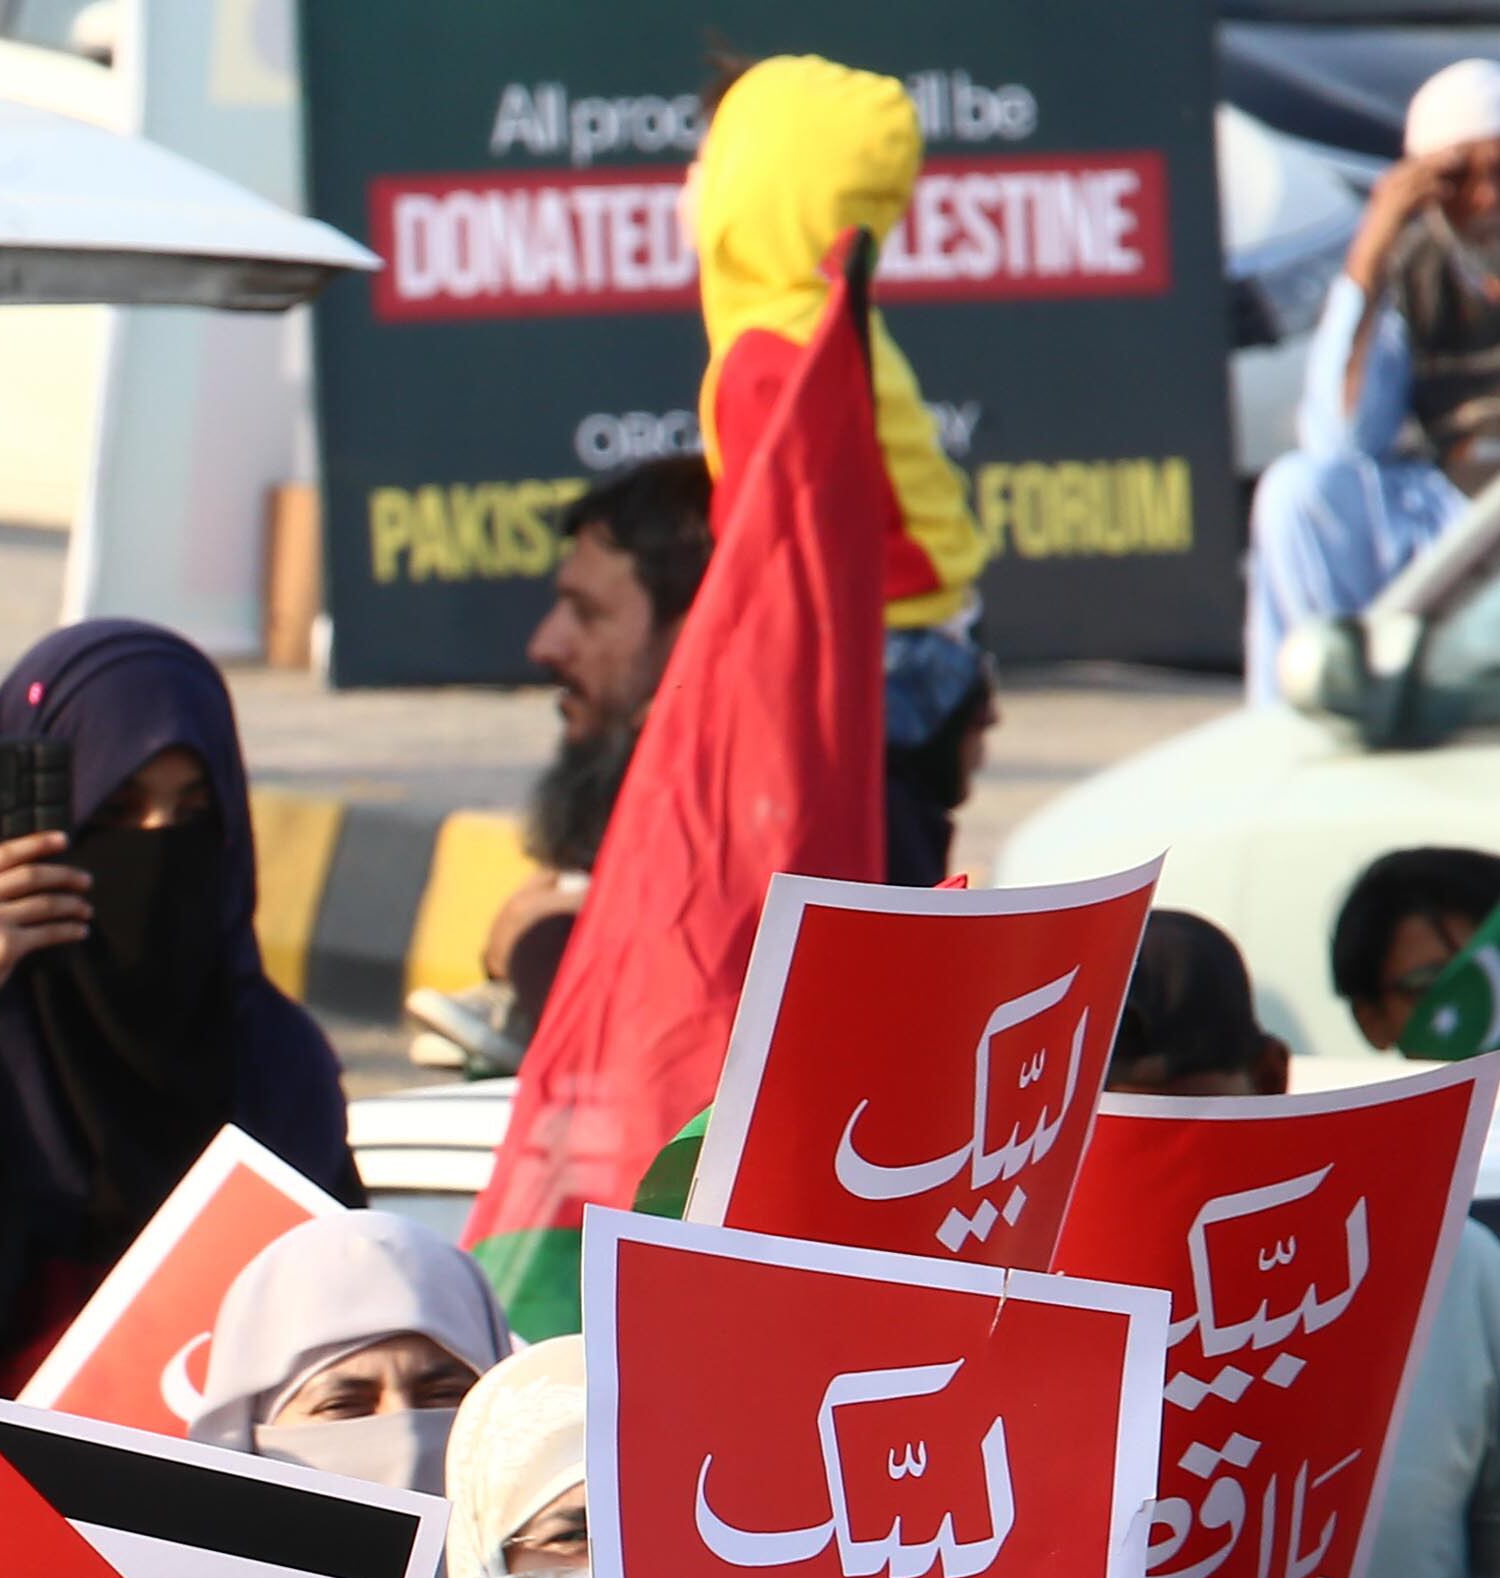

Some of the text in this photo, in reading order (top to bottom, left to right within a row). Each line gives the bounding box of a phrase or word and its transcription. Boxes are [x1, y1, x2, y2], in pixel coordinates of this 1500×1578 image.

[490, 82, 566, 156] All
[952, 68, 1038, 142] be
[395, 186, 697, 301] DONATED
[977, 457, 1193, 559] FORUM
